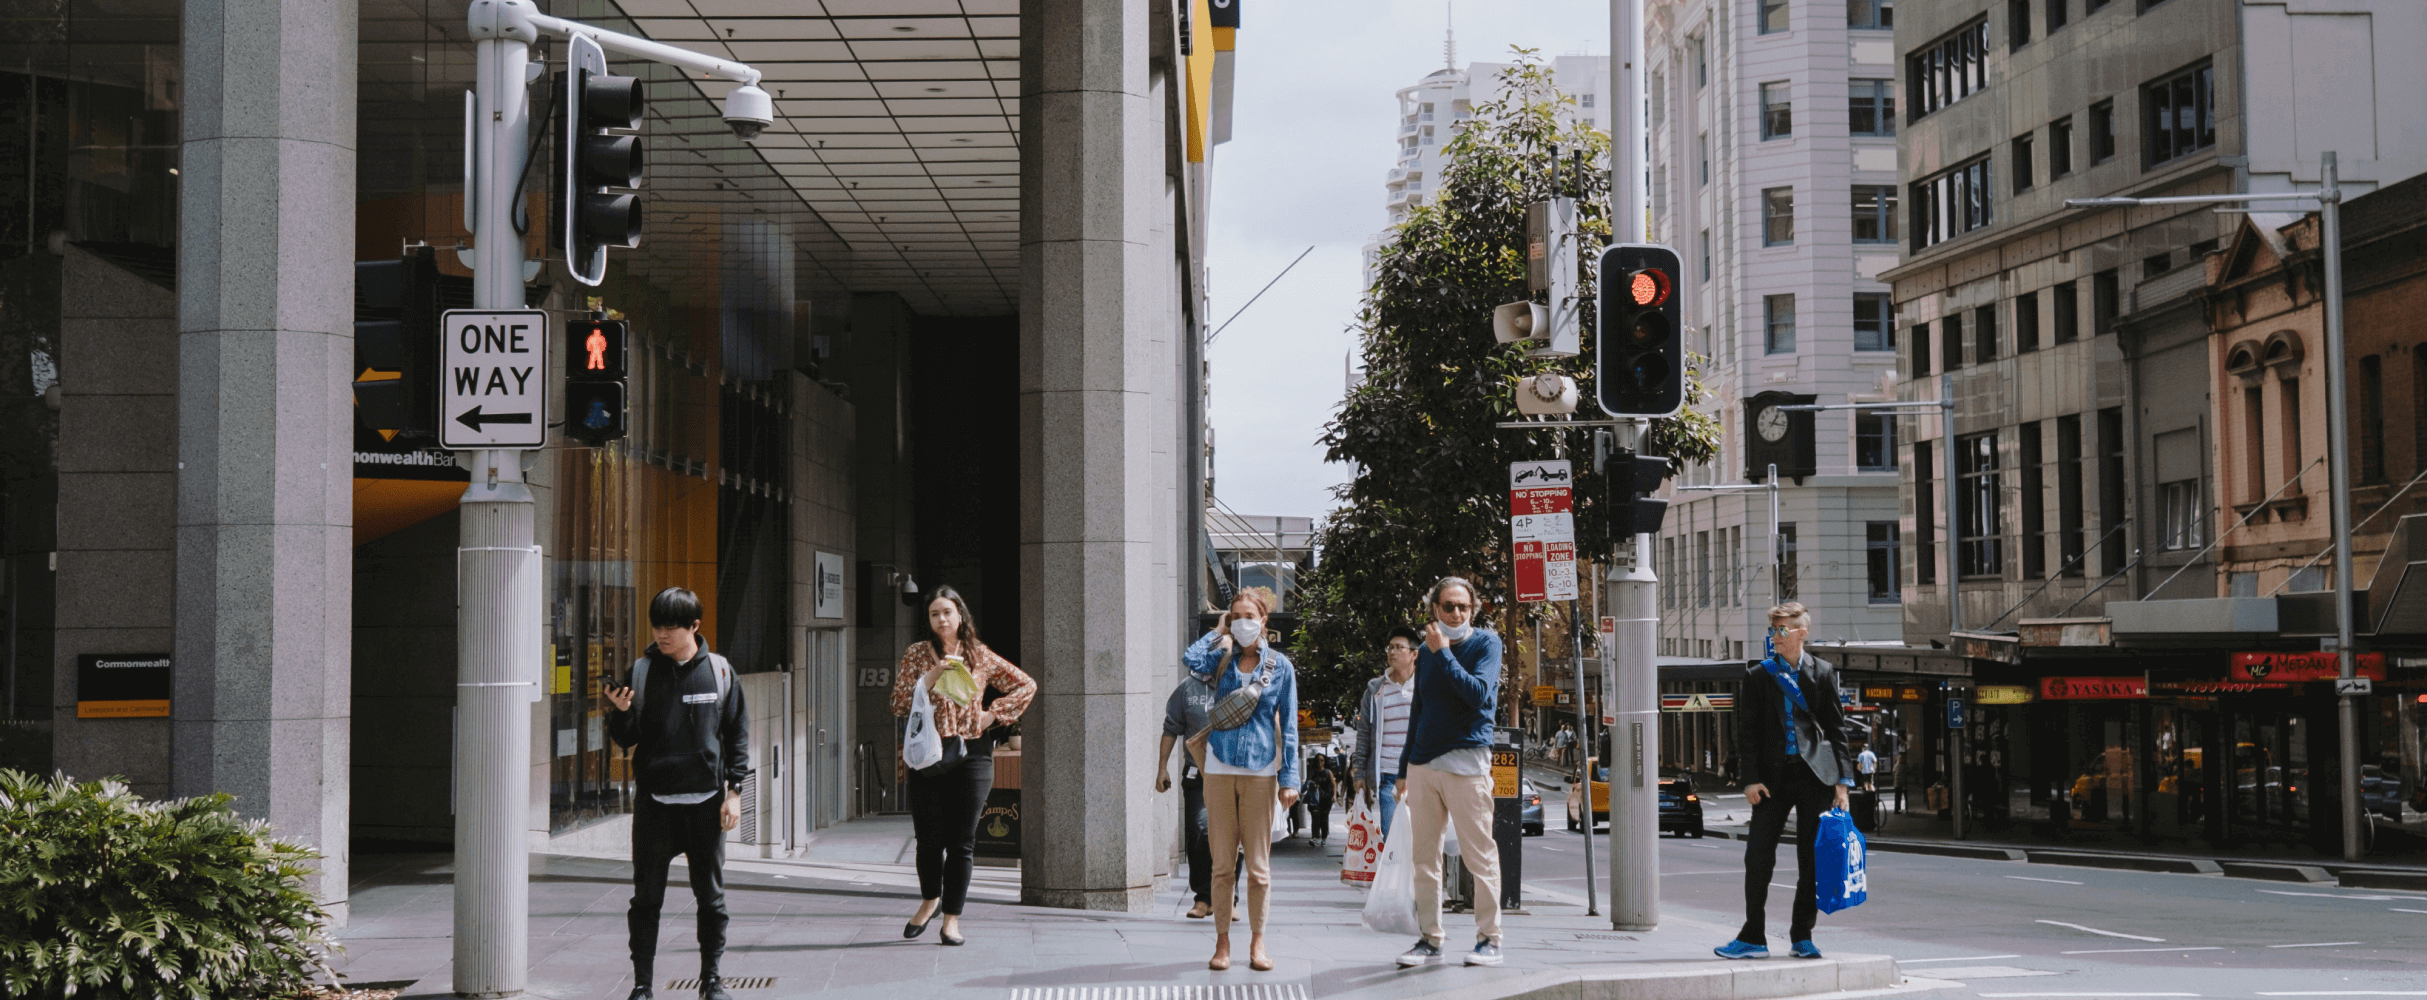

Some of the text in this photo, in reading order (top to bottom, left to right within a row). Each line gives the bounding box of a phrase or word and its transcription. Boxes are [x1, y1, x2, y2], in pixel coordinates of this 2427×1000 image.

[460, 324, 529, 354] ONE
[454, 366, 534, 396] WAY
[1530, 489, 1568, 497] STOPPING
[1516, 517, 1533, 528] 4P
[1523, 544, 1534, 552] NO
[1546, 542, 1573, 551] LOADING
[1515, 552, 1543, 560] STOPPING
[1550, 552, 1570, 560] ZONE
[2250, 665, 2267, 676] MC
[858, 668, 890, 687] 133
[2072, 683, 2132, 695] YASAKA
[1953, 701, 1960, 712] P
